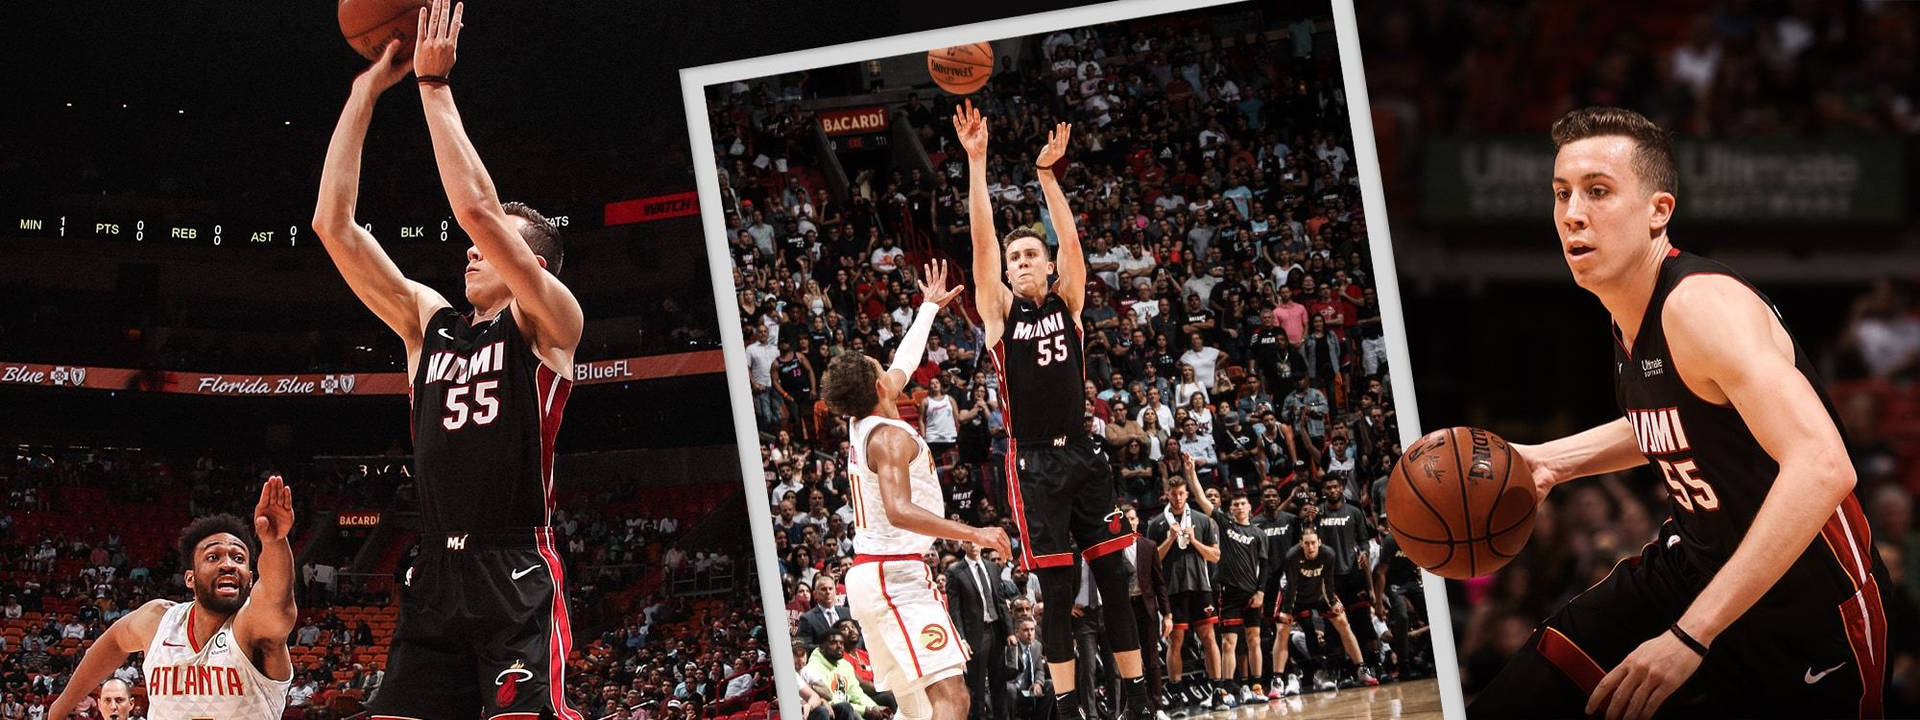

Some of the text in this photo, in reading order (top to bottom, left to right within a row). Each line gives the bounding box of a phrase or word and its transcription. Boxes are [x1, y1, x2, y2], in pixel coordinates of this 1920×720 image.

[823, 109, 885, 133] BACARDÍ
[20, 219, 42, 230] MIN
[60, 216, 66, 226] 1
[137, 220, 144, 231] 0
[441, 220, 448, 231] 0
[59, 227, 65, 237] 1
[96, 223, 119, 235] PTS
[171, 227, 197, 239] REB
[214, 225, 222, 235] 0
[290, 225, 297, 236] 0
[401, 226, 424, 238] BLK
[136, 231, 144, 241] 0
[213, 235, 221, 246] 0
[250, 231, 274, 242] AST
[290, 236, 297, 247] 1
[440, 231, 448, 241] 0
[1012, 311, 1065, 340] MIAMI
[1037, 334, 1068, 366] 55
[425, 341, 505, 385] MIAMI
[1641, 358, 1663, 371] Ultimate
[2, 367, 44, 383] Blue
[199, 377, 315, 394] Florida Blue
[443, 380, 500, 430] 55
[1657, 459, 1719, 511] 55
[953, 490, 973, 501] HEAT
[339, 513, 380, 526] BACARDÍ
[1320, 516, 1350, 527] HEAT
[150, 665, 244, 696] ATLANTA
